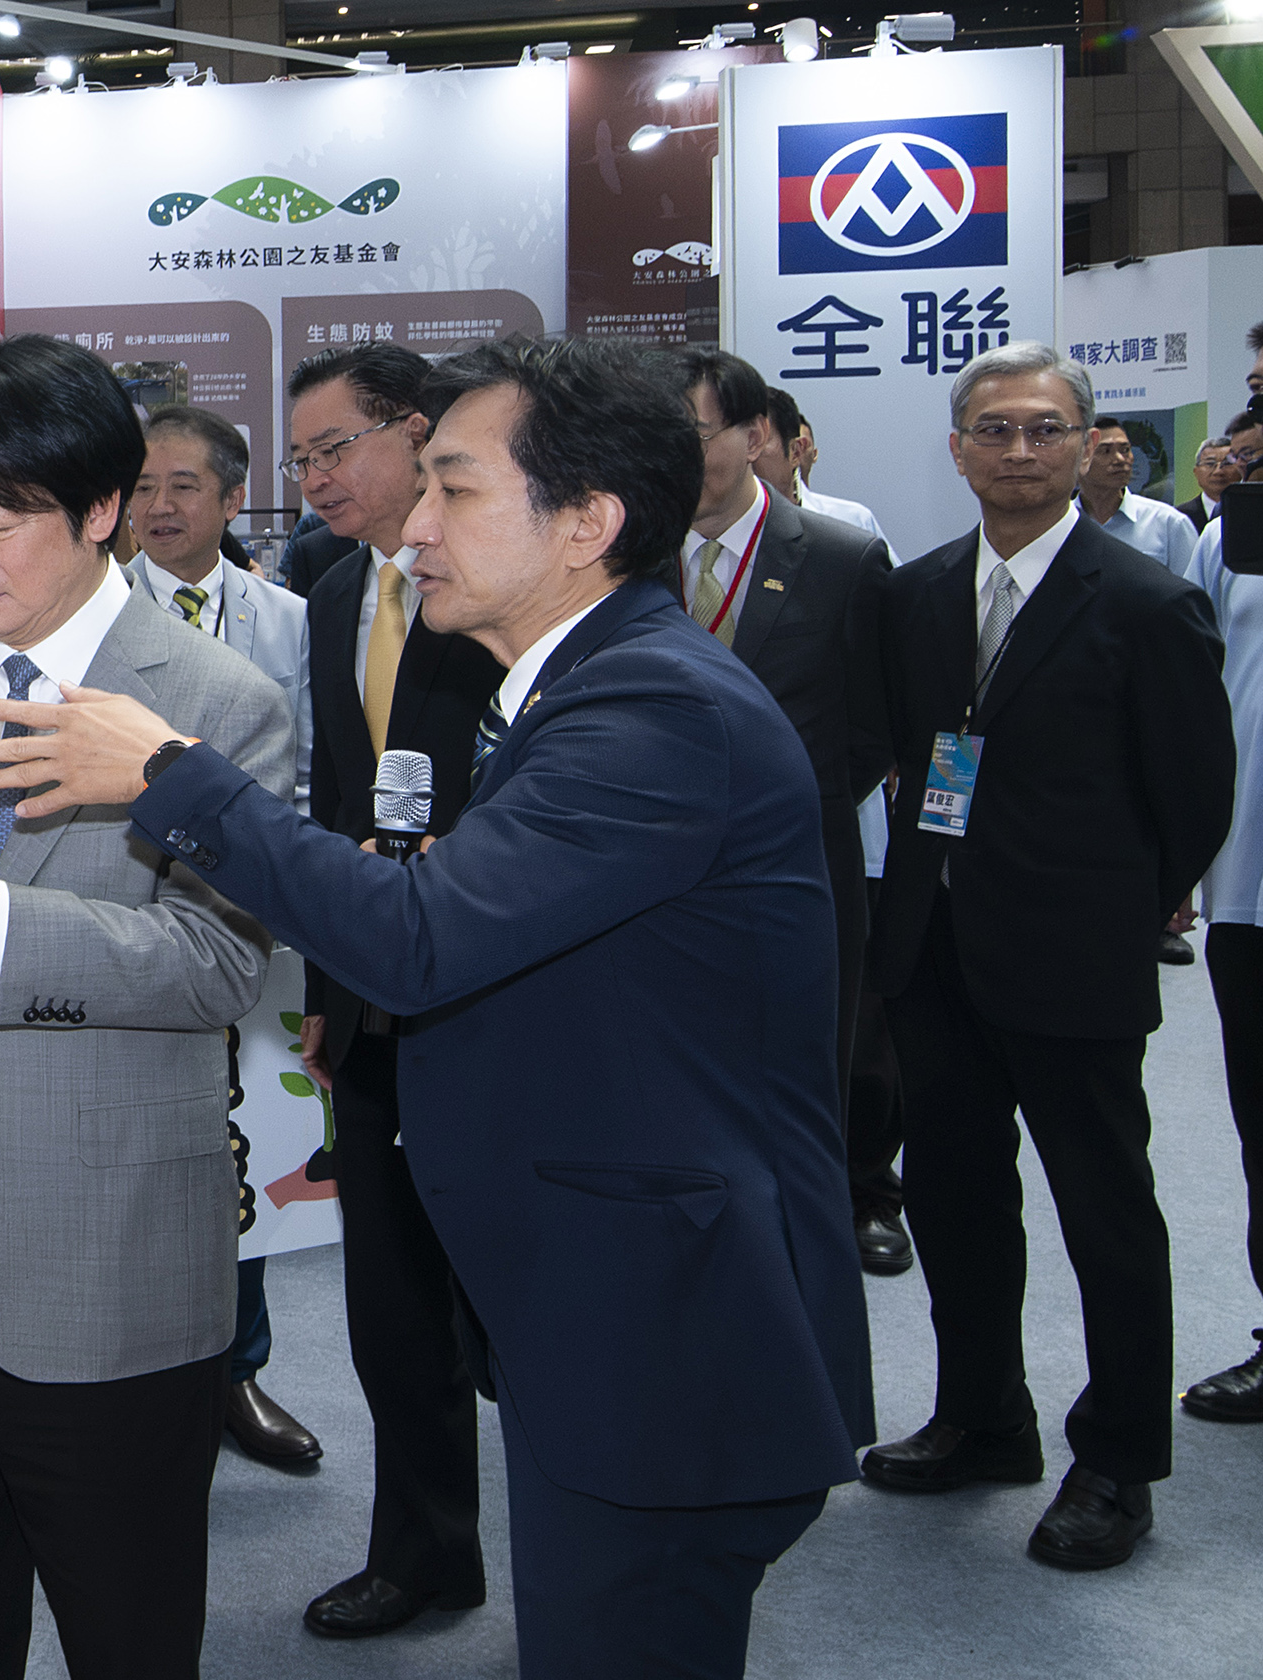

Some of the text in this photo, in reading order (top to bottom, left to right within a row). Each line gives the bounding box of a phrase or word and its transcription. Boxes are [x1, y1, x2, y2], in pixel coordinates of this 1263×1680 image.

[148, 241, 401, 272] 大安森林公園之友基金會
[307, 321, 394, 343] 生態防蚊
[776, 286, 1011, 380] 全聯
[1069, 336, 1158, 366] 獨家大調查
